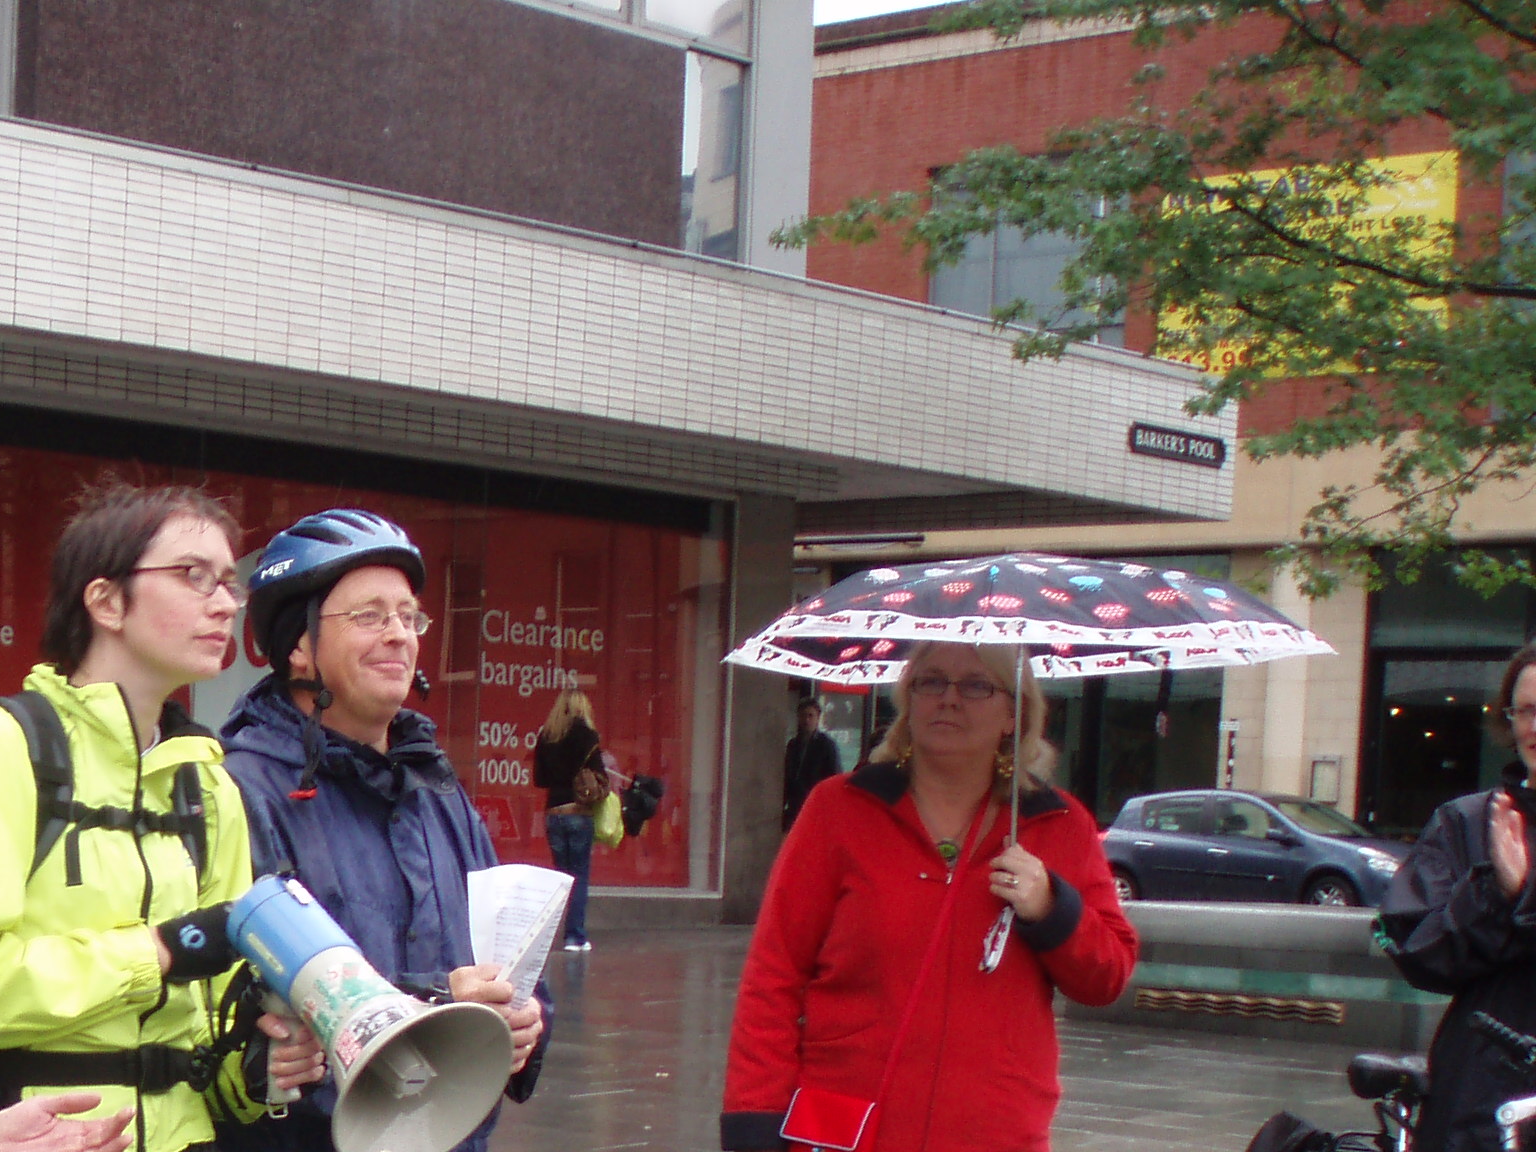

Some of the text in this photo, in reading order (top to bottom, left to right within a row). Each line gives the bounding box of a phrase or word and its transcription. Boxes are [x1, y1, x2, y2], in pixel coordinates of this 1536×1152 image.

[1135, 429, 1216, 460] BARKER'S POOL
[261, 558, 295, 580] MET
[481, 609, 605, 651] Clearance
[480, 650, 579, 697] bargains
[478, 721, 519, 749] 50%
[478, 758, 530, 786] 1000s
